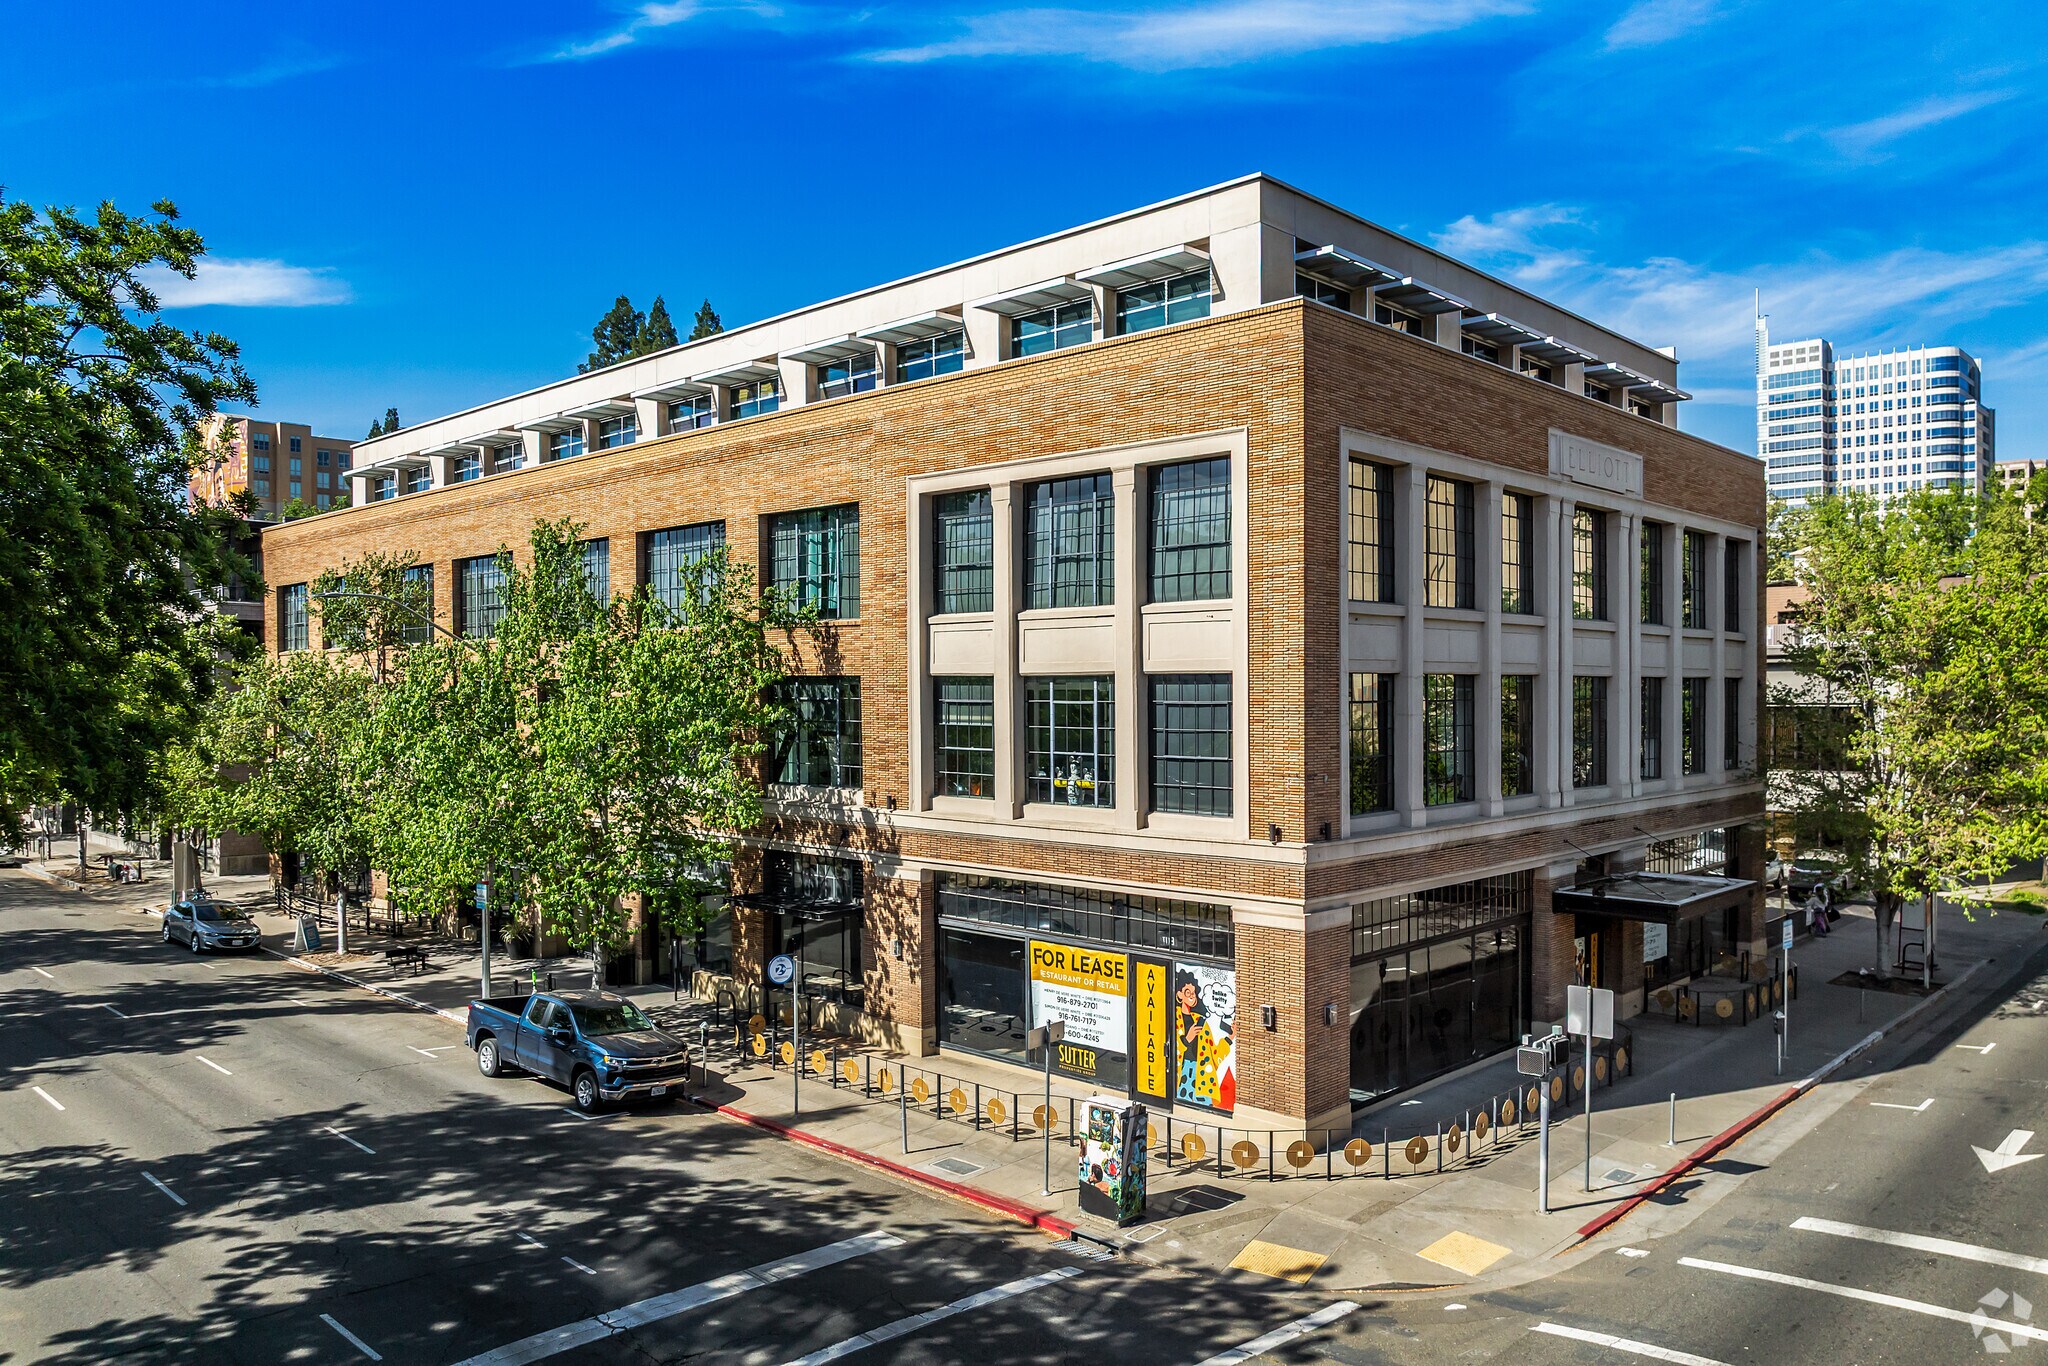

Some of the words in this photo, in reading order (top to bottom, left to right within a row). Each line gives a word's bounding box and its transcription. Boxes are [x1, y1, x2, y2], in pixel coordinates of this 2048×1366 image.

[1568, 446, 1630, 483] ELLIOTT
[1033, 948, 1065, 970] FOR
[1071, 954, 1124, 979] LEASE
[1083, 978, 1094, 987] OR
[1096, 980, 1121, 991] RETAIL
[1056, 995, 1098, 1009] 916-879-2701
[1058, 1011, 1097, 1026] 916-761-7179
[1064, 1029, 1100, 1043] -600-4245
[1146, 968, 1156, 1091] AVAILABLE
[1058, 1044, 1096, 1070] SUTTER
